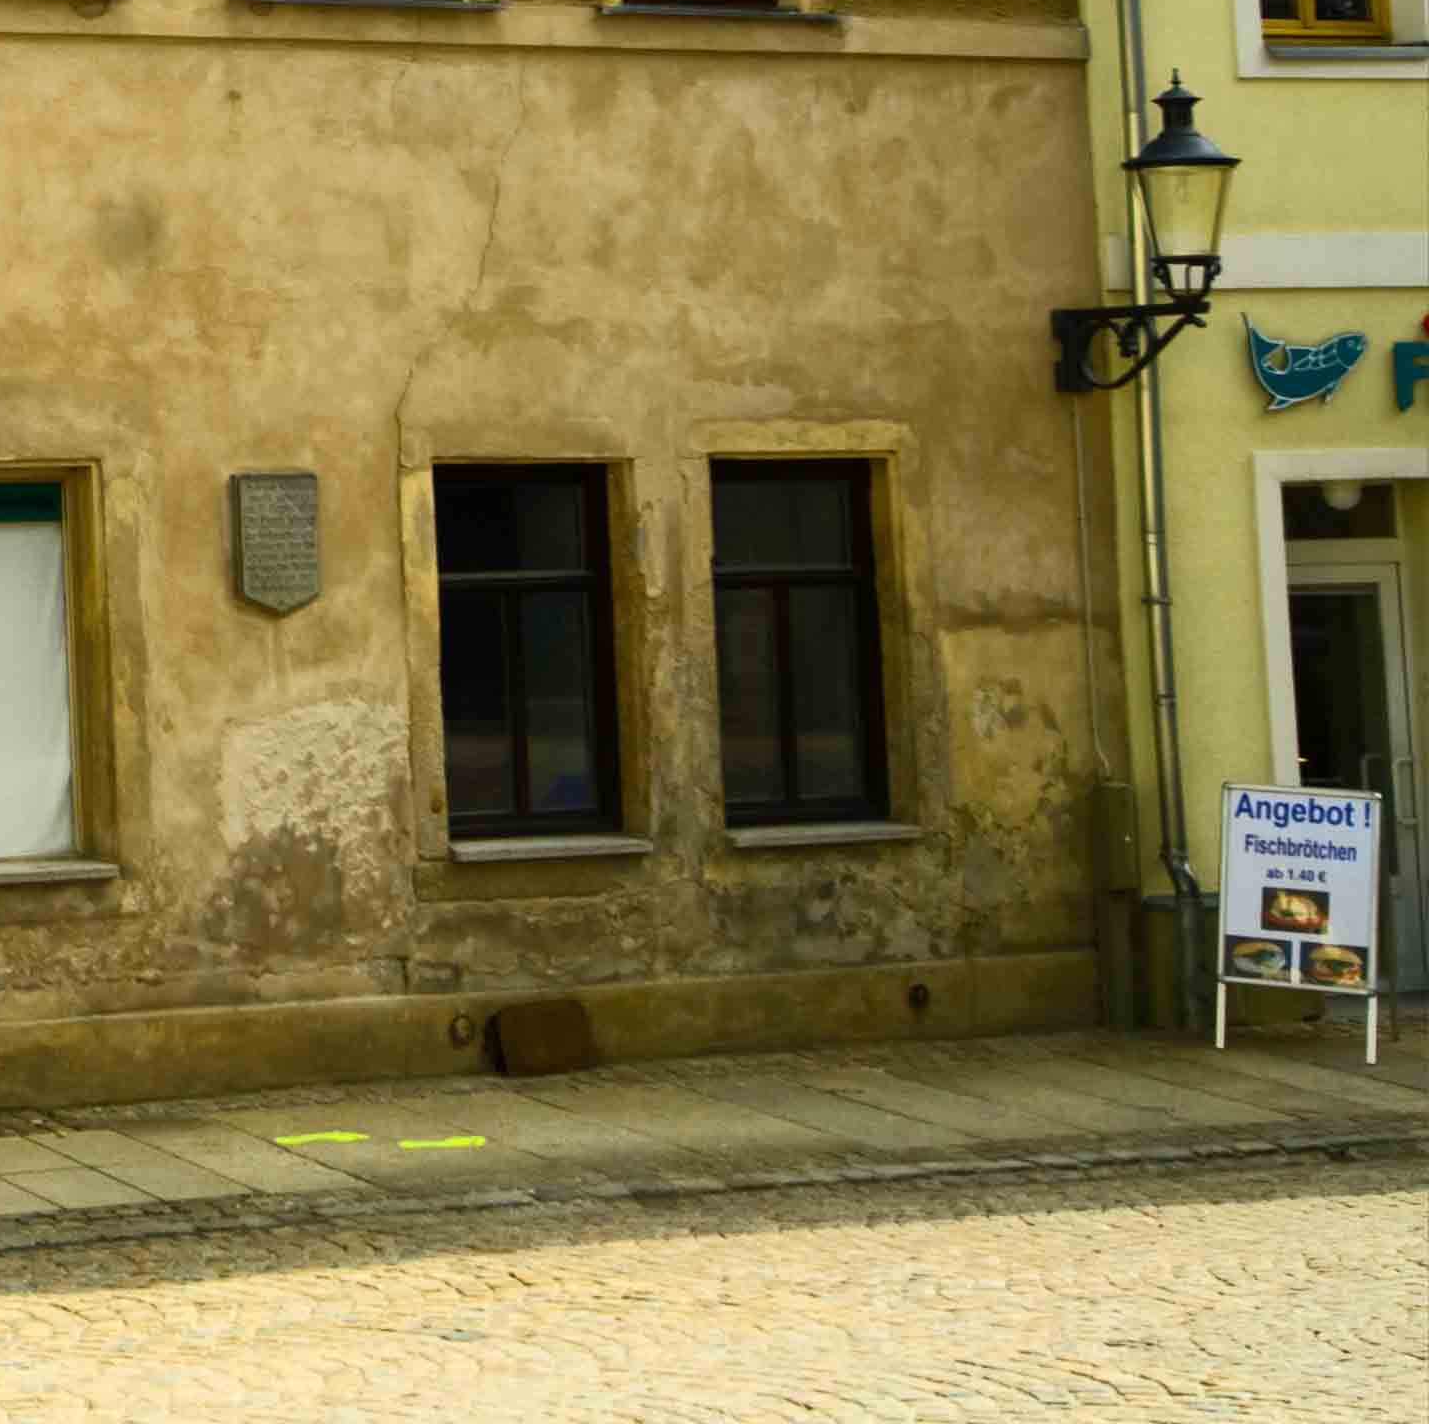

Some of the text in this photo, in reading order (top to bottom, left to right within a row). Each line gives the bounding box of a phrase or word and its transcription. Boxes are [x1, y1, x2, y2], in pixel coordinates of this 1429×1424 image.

[1234, 792, 1371, 828] Angebot !
[1244, 834, 1357, 862] Fischbrötchen
